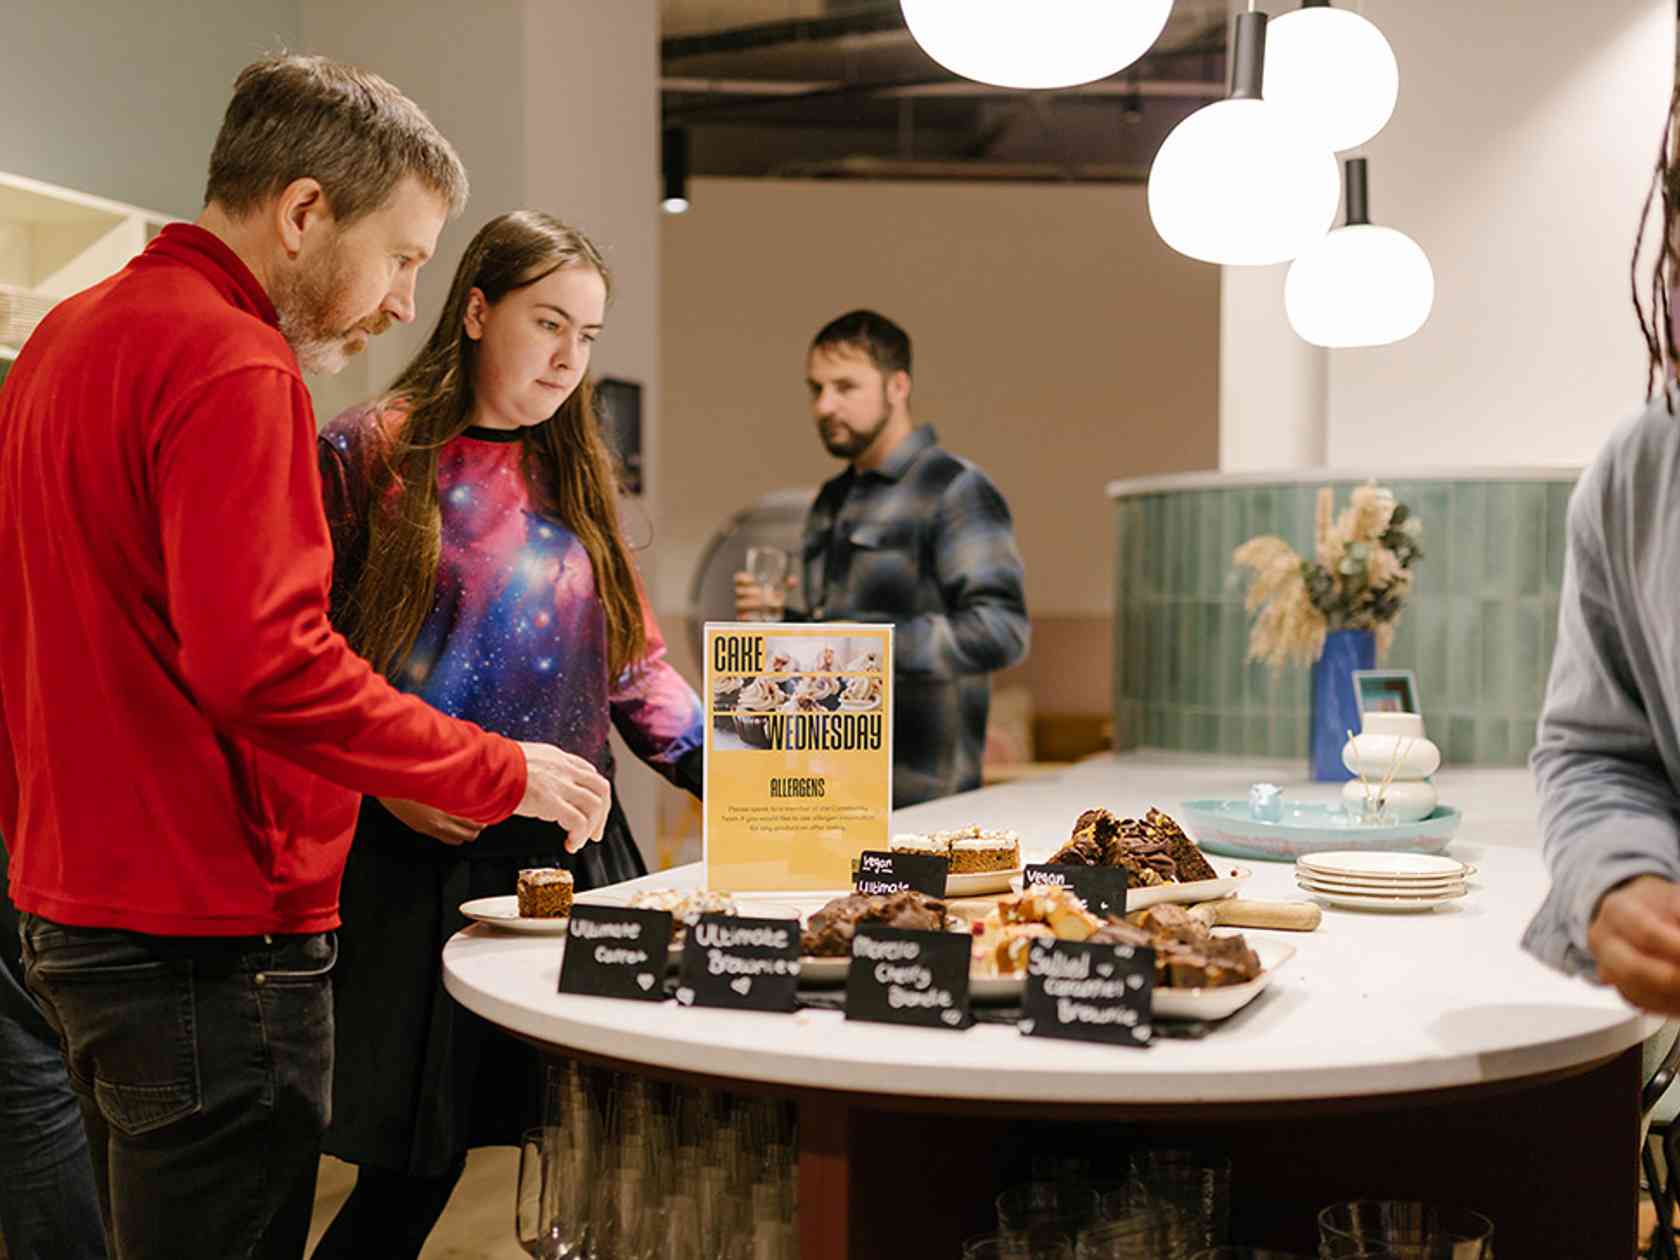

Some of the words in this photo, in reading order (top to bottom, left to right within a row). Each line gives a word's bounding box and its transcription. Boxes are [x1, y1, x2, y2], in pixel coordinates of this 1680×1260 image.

[714, 635, 764, 673] CAKE
[767, 713, 883, 751] WEDNESDAY
[770, 777, 825, 798] ALLERGENS
[695, 923, 789, 949] Ultimate
